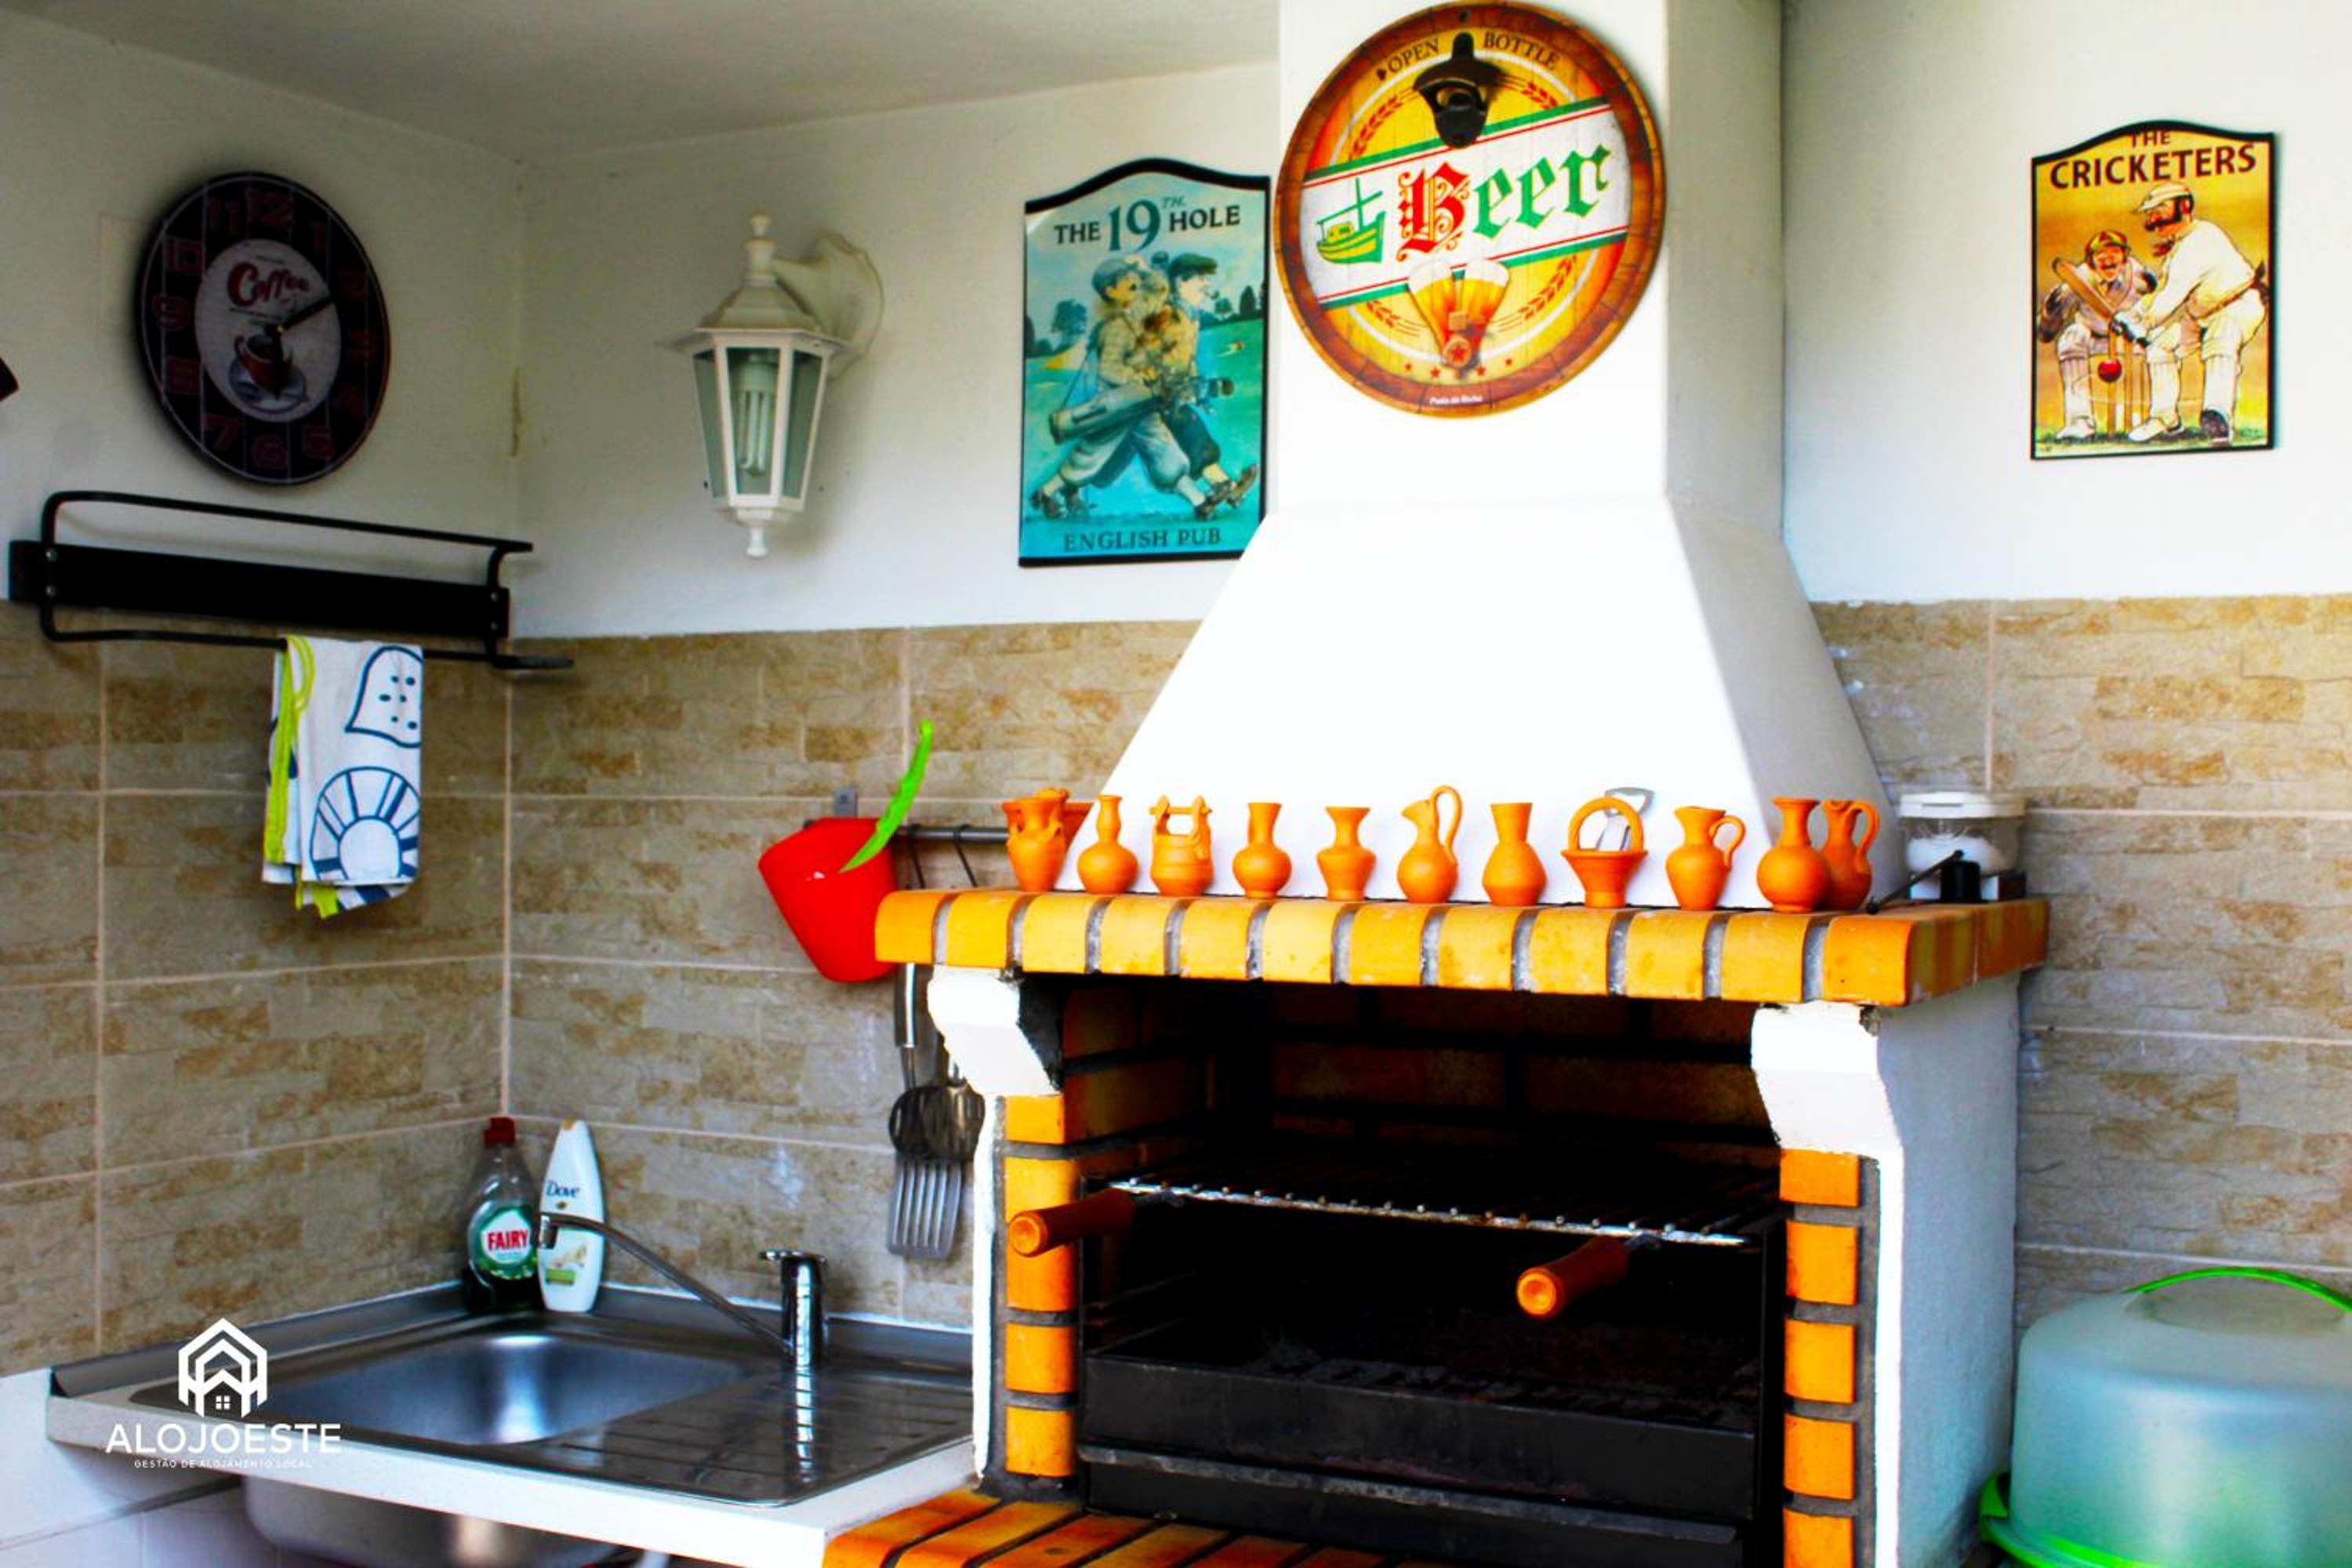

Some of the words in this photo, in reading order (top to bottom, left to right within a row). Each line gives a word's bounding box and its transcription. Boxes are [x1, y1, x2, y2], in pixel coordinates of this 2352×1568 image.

[1388, 38, 1439, 72] OPEN
[1483, 31, 1560, 71] BOTTLE
[2130, 130, 2170, 147] THE
[2050, 144, 2256, 189] CRICKETERS
[1396, 143, 1610, 263] Beer
[1054, 221, 1102, 244] THE
[1169, 205, 1240, 233] HOLE
[227, 262, 310, 307] Coffee
[1063, 531, 1169, 554] ENGLISH
[1177, 528, 1222, 547] PUB
[546, 1181, 580, 1198] Dove
[488, 1229, 528, 1250] FAIRY
